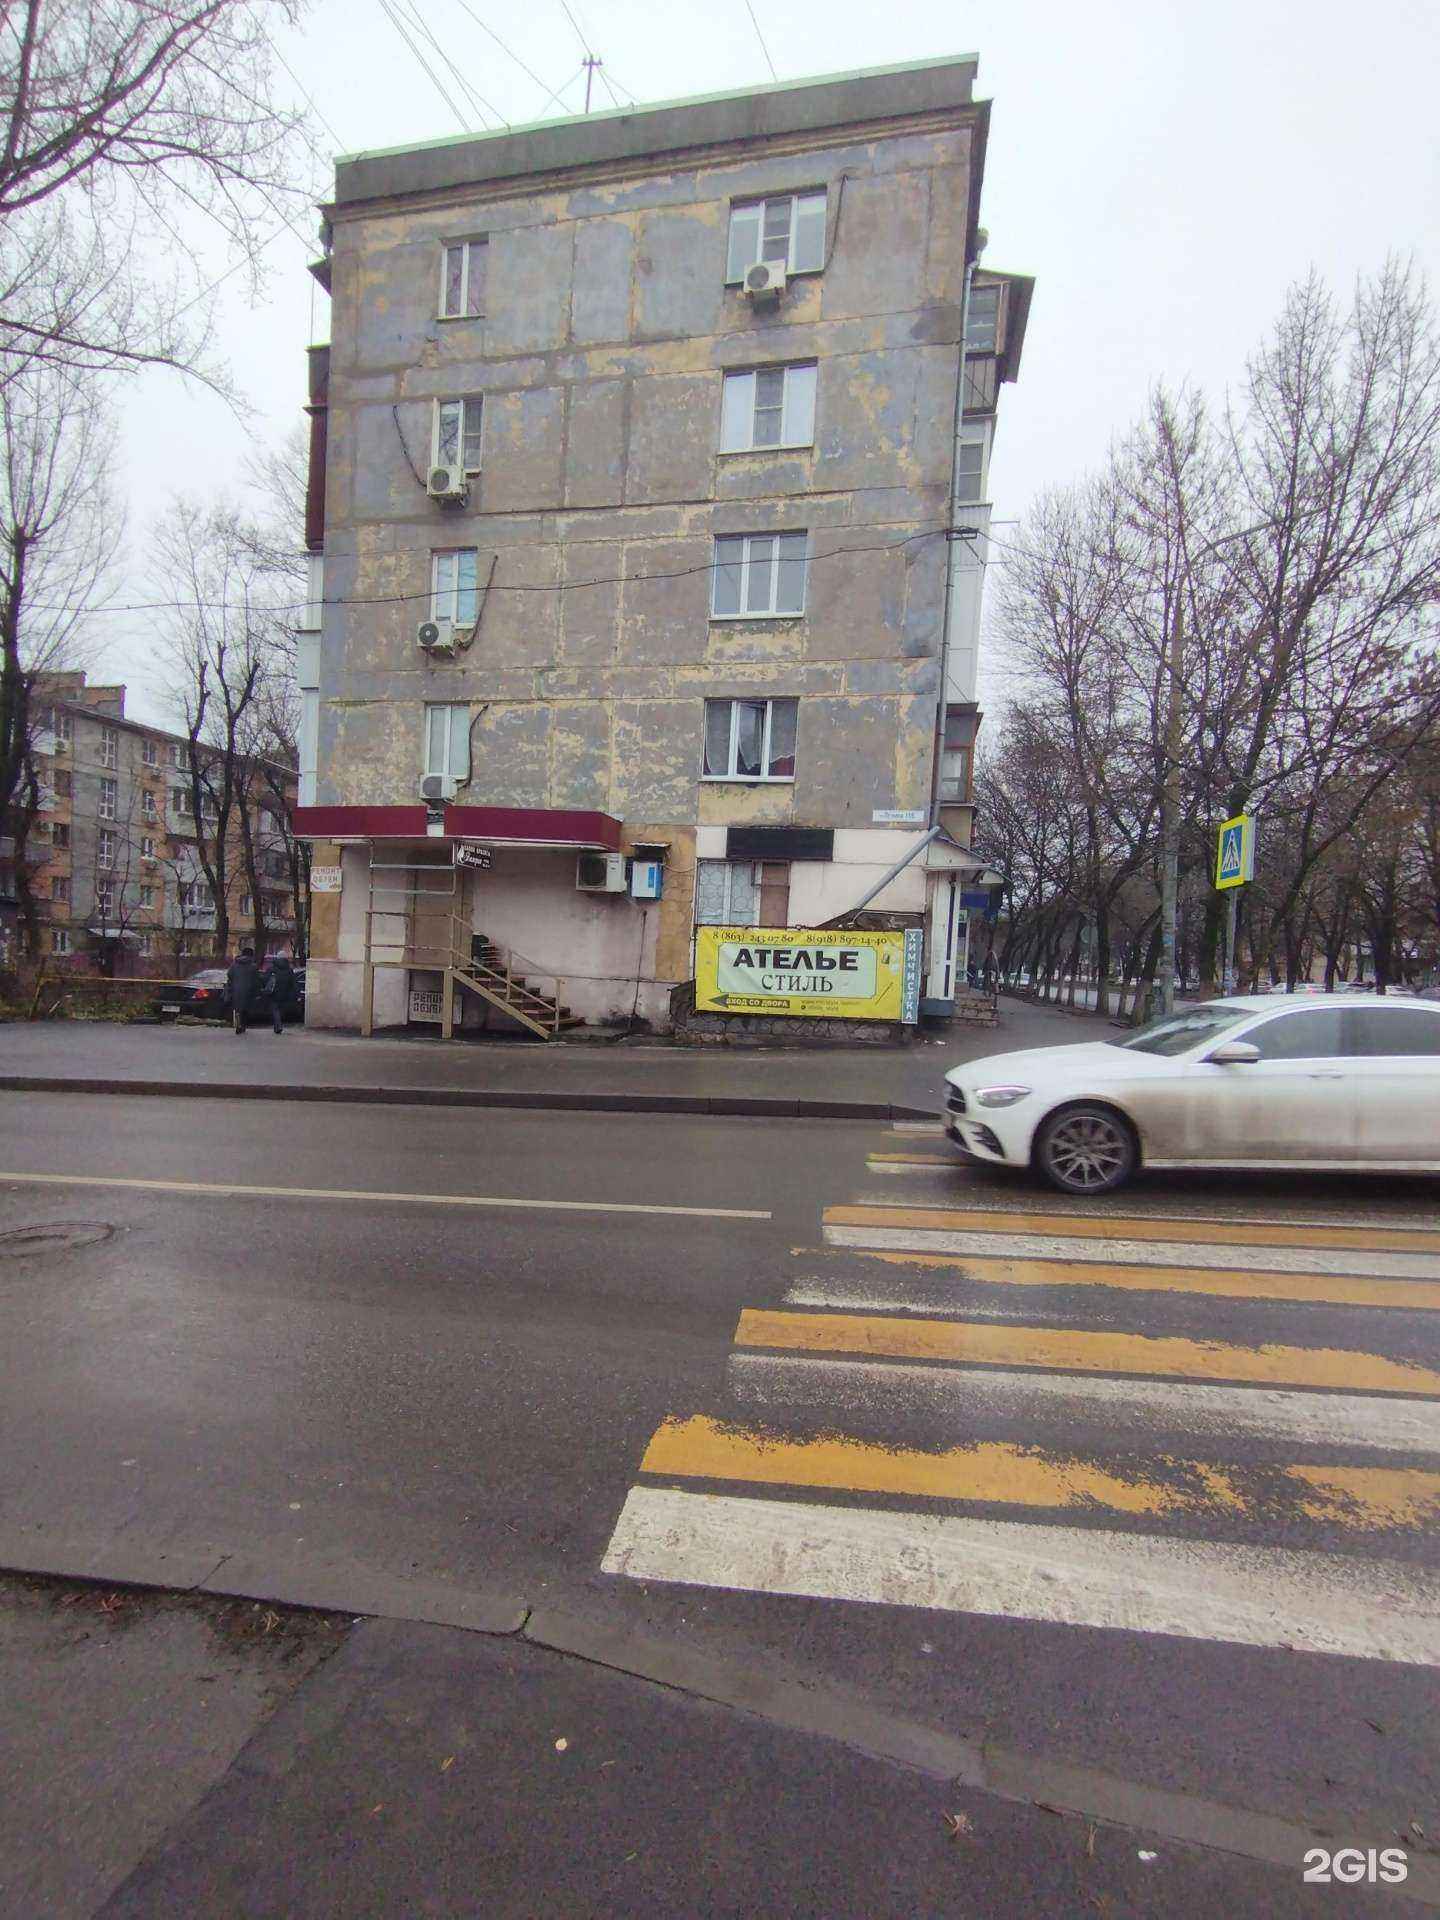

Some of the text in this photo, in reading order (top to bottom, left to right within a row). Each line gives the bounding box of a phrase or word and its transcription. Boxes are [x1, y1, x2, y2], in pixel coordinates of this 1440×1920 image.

[712, 931, 719, 940] 8
[721, 931, 745, 942] (863)
[781, 934, 794, 943] 80
[733, 948, 859, 971] АТЕЛЬЕ
[761, 973, 833, 992] СТИЛЬ
[905, 932, 917, 1020] ХИМЧИСТКА
[725, 997, 788, 1008] ВХОД СО ДВОРА
